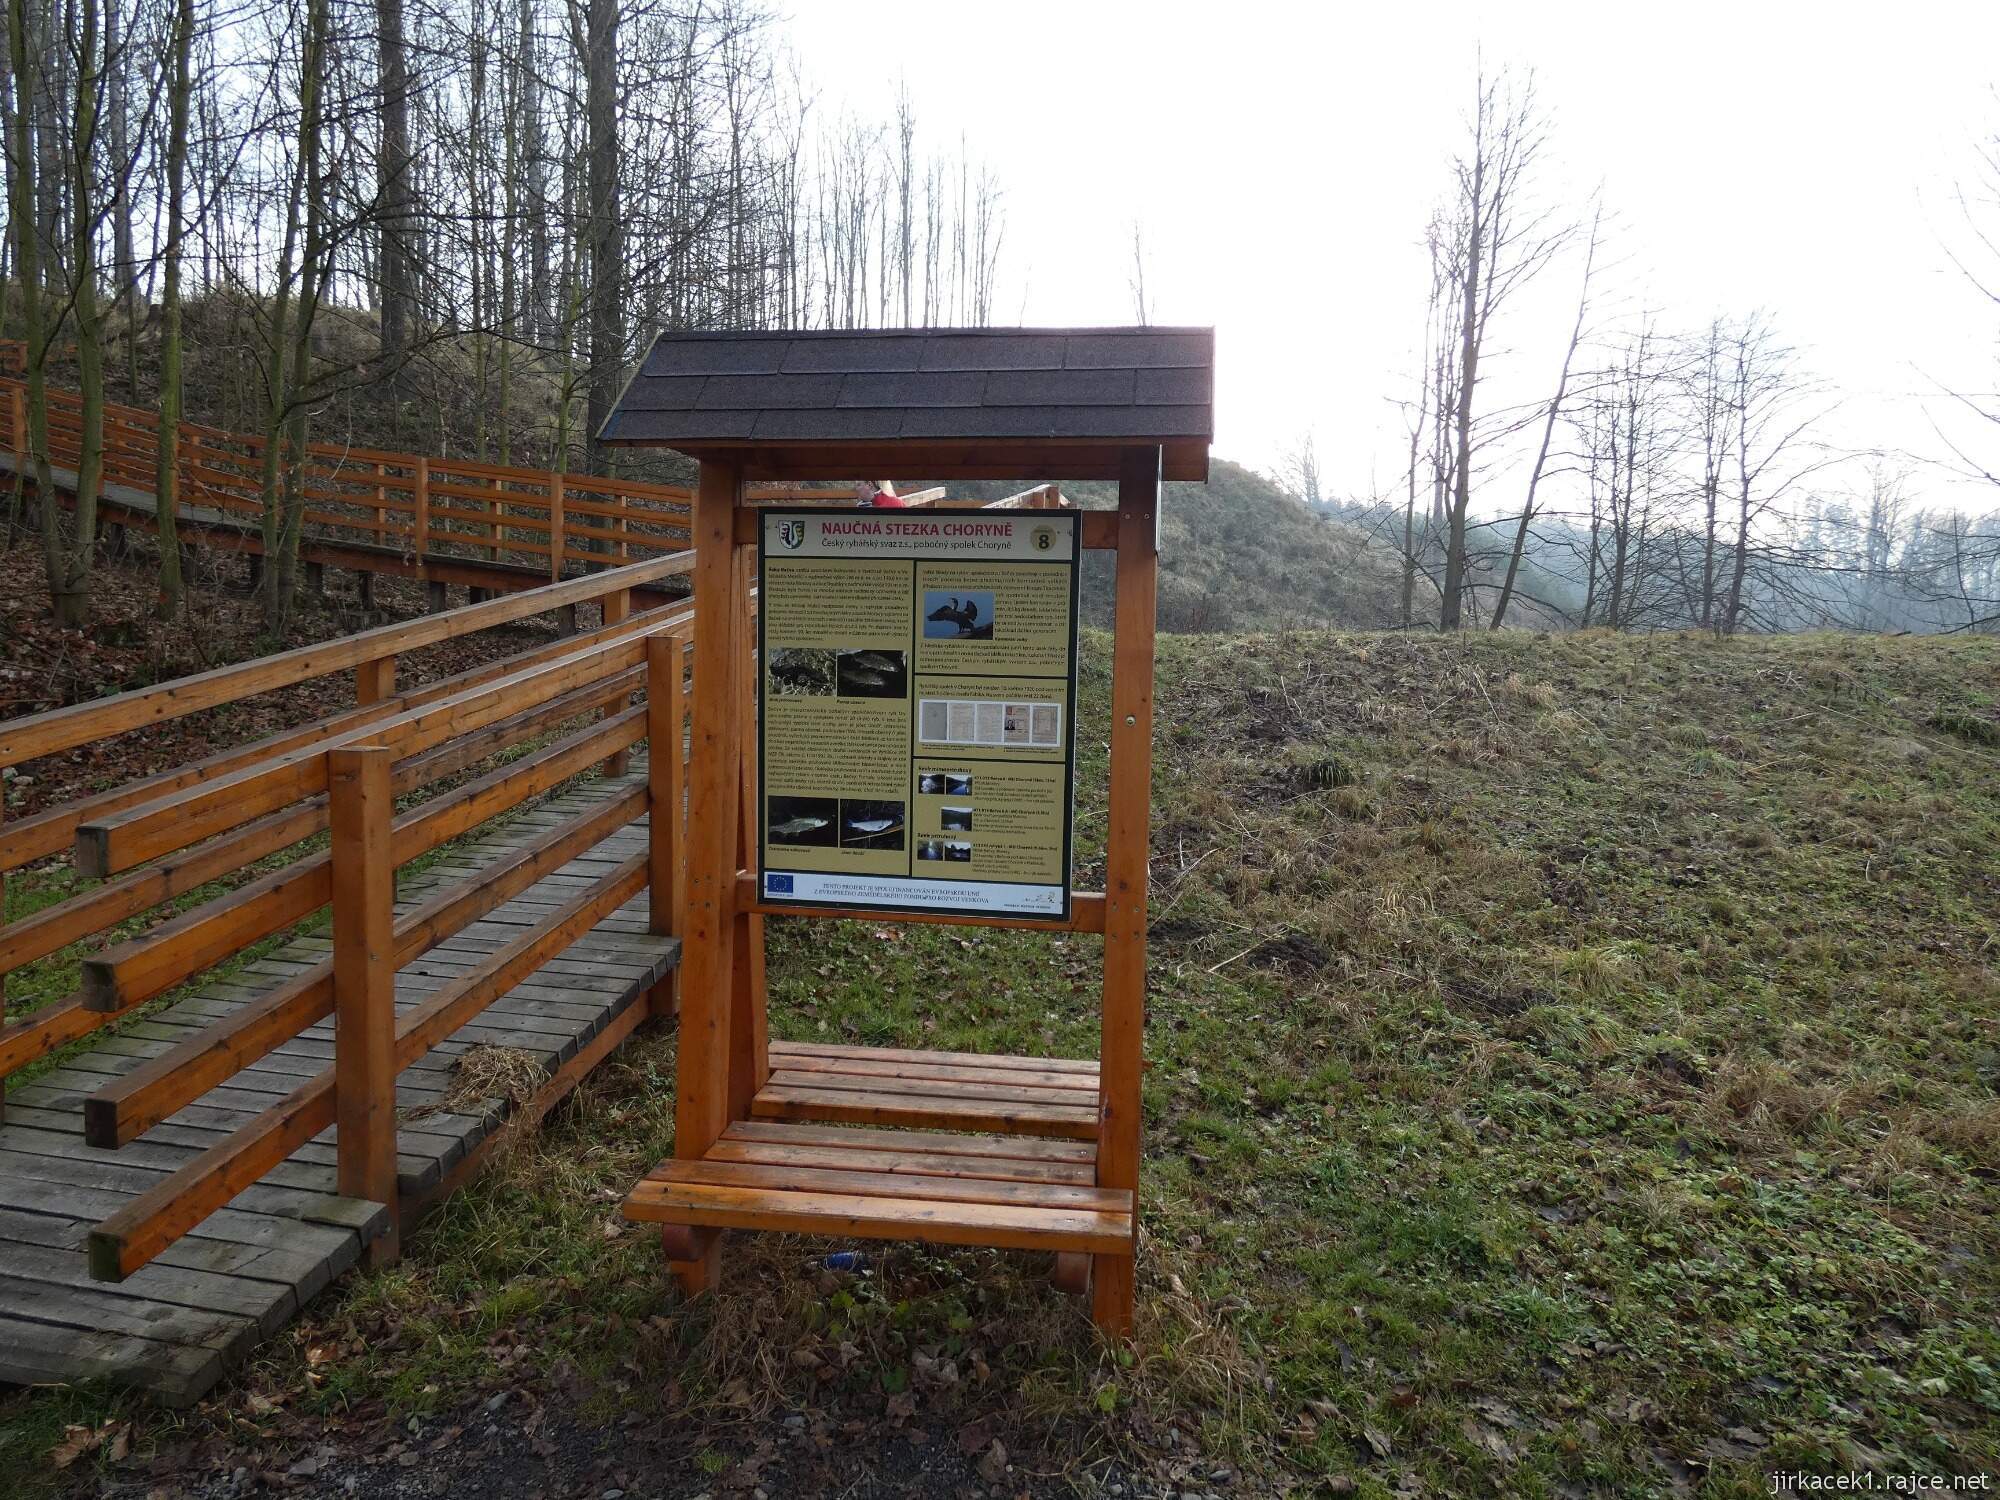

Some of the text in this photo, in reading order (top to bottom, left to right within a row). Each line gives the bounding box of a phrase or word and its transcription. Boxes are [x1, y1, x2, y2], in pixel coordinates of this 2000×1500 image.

[821, 520, 1012, 537] NAUČNÁ STEZKA CHORYNĚ
[821, 538, 845, 548] Český
[845, 539, 878, 550] rybářský
[913, 540, 948, 551] pobočný
[950, 541, 976, 551] spolek
[977, 541, 1012, 552] Choryně
[1038, 534, 1050, 550] 8
